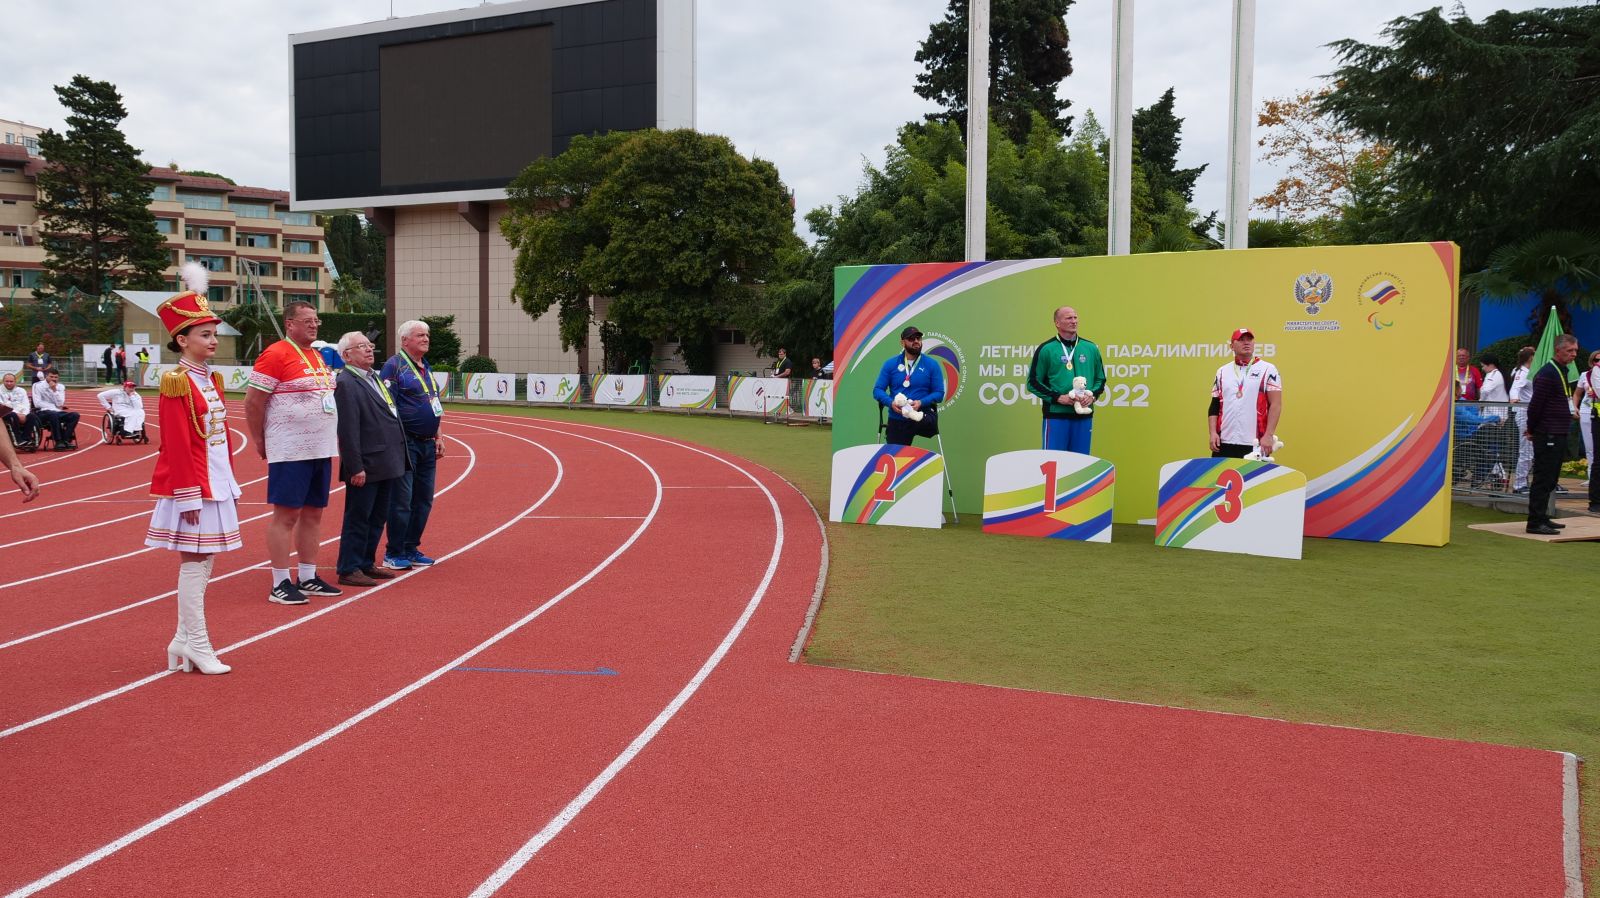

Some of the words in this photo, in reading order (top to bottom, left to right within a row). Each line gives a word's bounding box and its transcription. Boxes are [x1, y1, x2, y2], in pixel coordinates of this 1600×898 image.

[979, 345, 1038, 358] ЛЕТНИ
[1106, 341, 1276, 358] ПАРАЛИМПИЙЕВ
[979, 364, 1005, 377] МЫ
[1104, 364, 1151, 378] ПОРТ
[978, 382, 1043, 405] СОЧ
[1094, 383, 1150, 407] 022
[874, 453, 897, 502] 2
[1040, 460, 1057, 512] 1
[1214, 468, 1244, 525] 3
